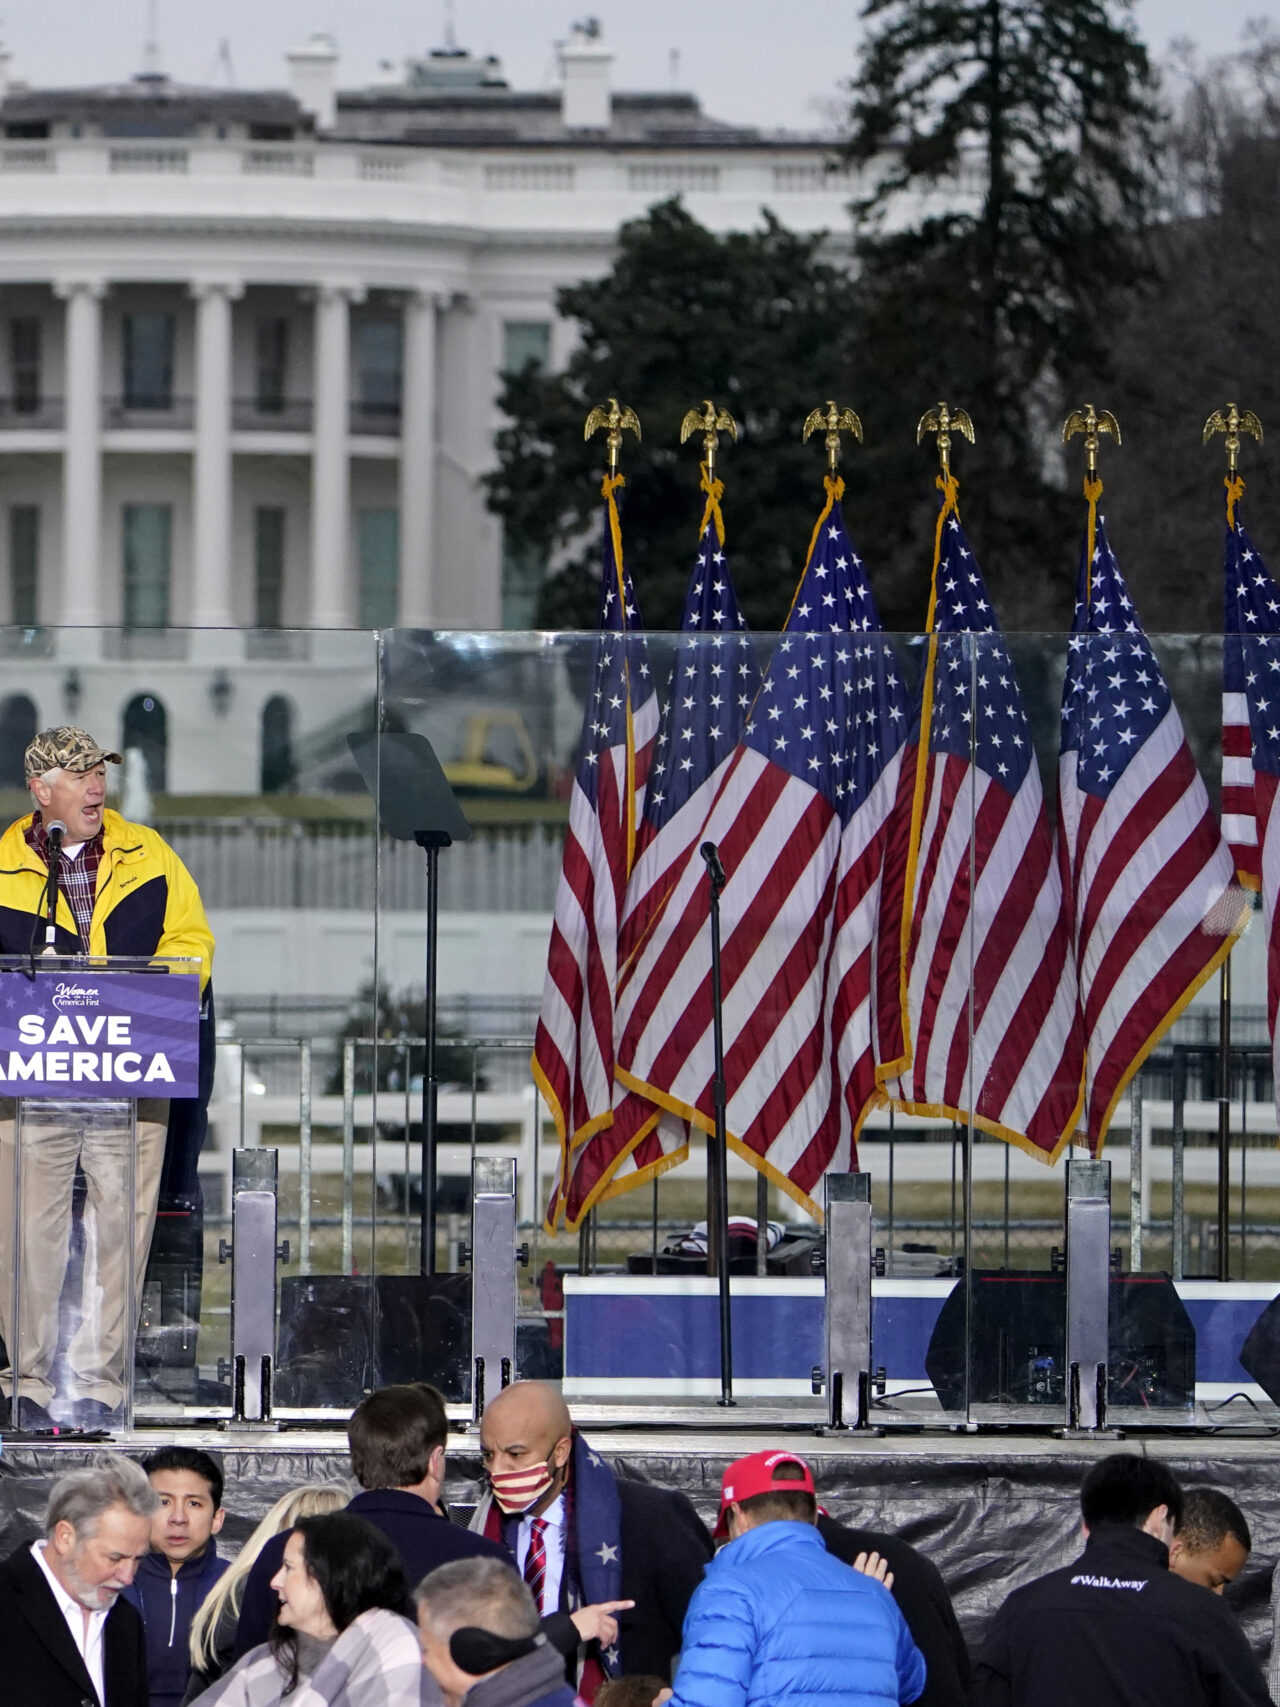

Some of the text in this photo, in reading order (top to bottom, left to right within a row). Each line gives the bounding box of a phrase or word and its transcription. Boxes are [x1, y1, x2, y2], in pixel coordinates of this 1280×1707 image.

[55, 982, 99, 996] Women
[57, 998, 99, 1006] America First
[18, 1014, 132, 1045] SAVE
[1070, 1575, 1149, 1592] #WalkAway
